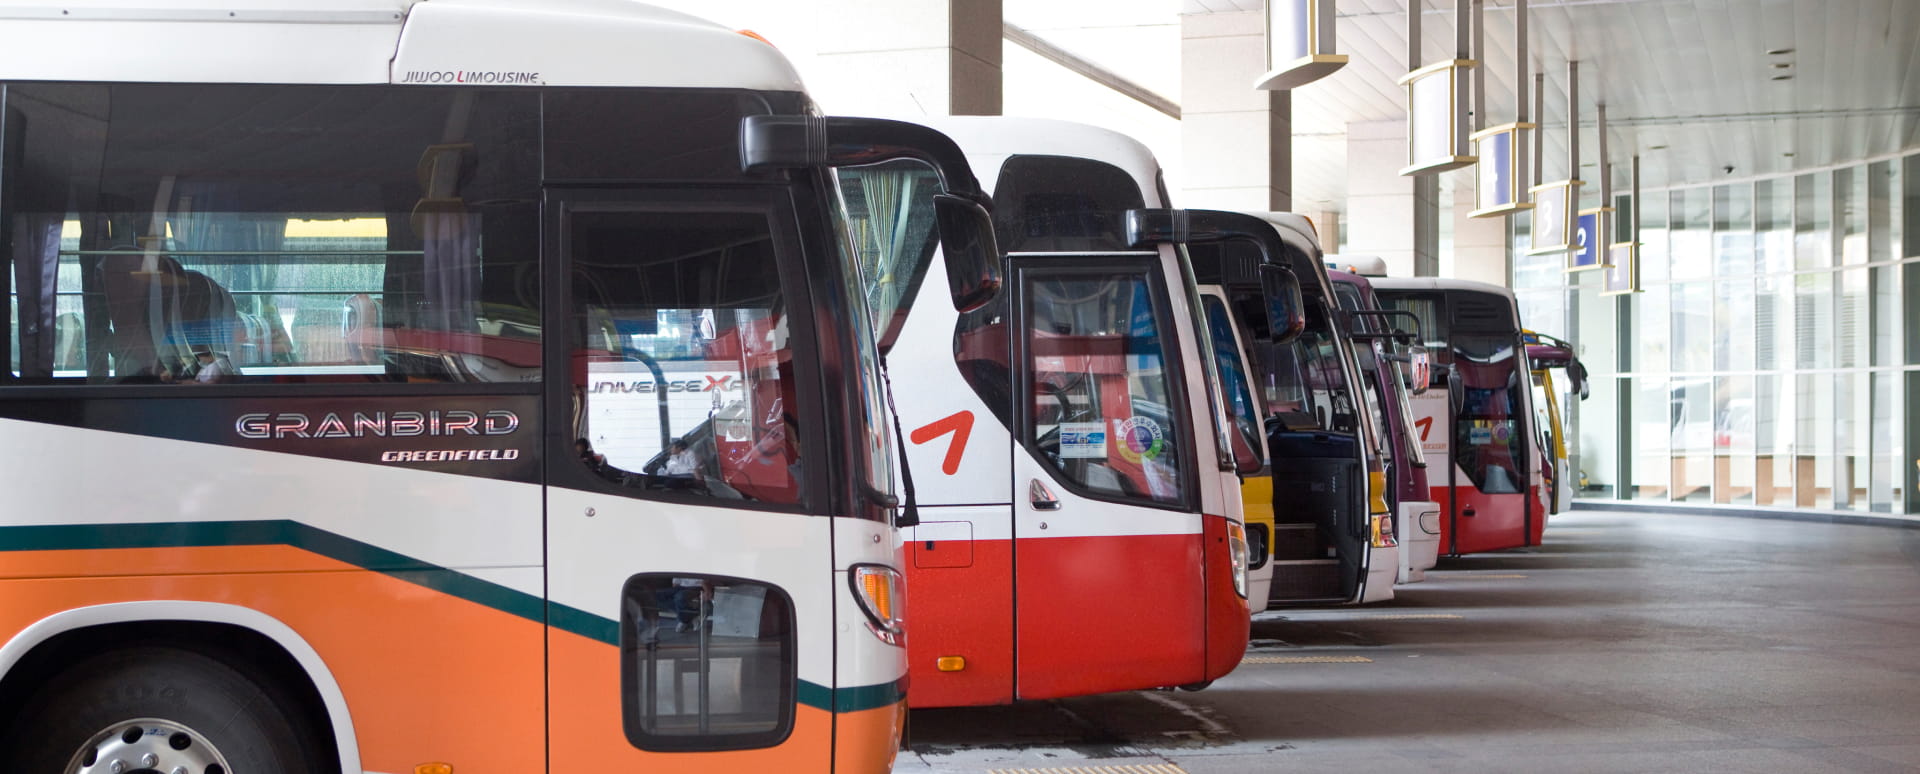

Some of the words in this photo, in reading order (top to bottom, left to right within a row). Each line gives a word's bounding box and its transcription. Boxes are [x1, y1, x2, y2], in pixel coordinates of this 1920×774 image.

[402, 71, 455, 83] JIWOO
[456, 70, 539, 84] LIMOUSINE
[1484, 148, 1498, 193] 4
[1541, 200, 1553, 240] 3
[1577, 227, 1588, 256] 2
[1611, 258, 1620, 282] 1
[235, 410, 520, 439] GRANBIRD
[381, 449, 519, 463] GREENFIELD
